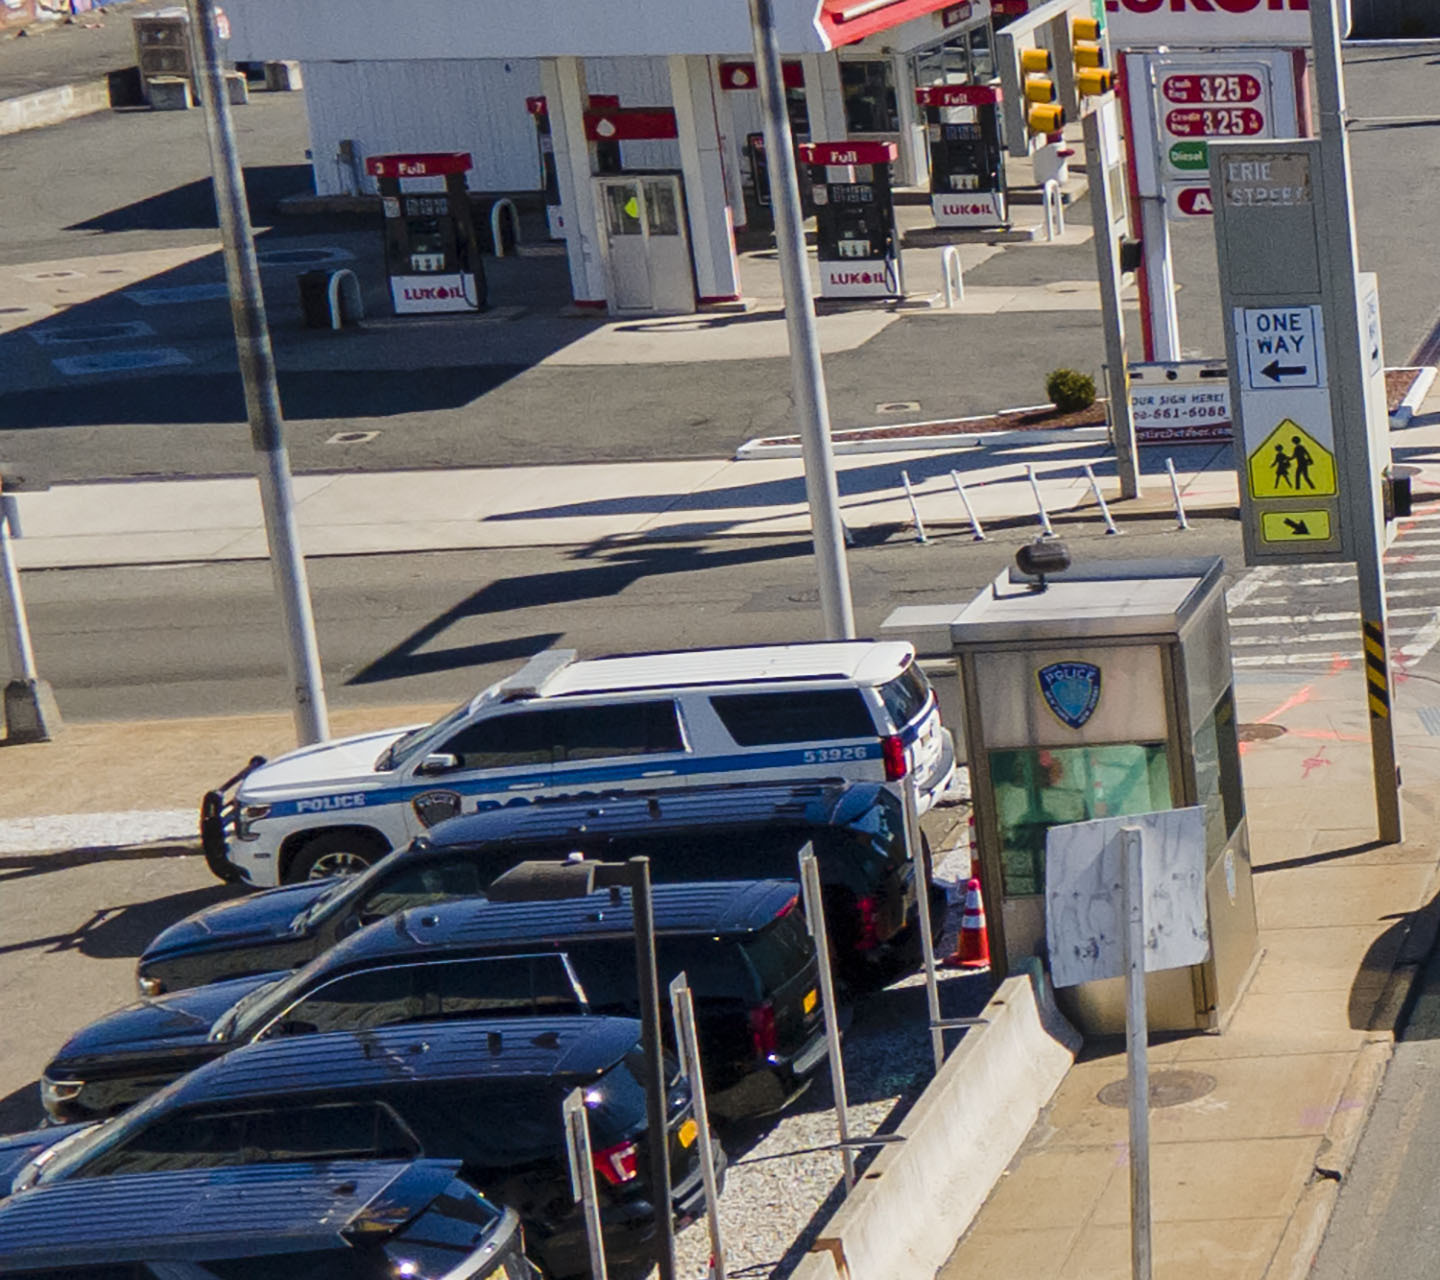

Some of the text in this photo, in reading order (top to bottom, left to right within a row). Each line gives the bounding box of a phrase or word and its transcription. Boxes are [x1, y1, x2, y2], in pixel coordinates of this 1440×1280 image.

[1169, 79, 1191, 89] Cash
[1200, 76, 1241, 102] 3.25
[944, 93, 968, 105] Full
[1202, 110, 1244, 134] 3.25
[830, 151, 857, 163] Full
[1171, 151, 1204, 162] Diesel
[398, 162, 426, 175] Full
[1229, 162, 1272, 182] ERIE
[943, 203, 993, 216] LUKOIL
[830, 271, 886, 286] LUKOIL
[403, 285, 463, 301] LUKOIL
[1257, 313, 1303, 333] ONE
[1257, 334, 1306, 355] WAY
[1160, 395, 1186, 406] SIGN
[1192, 393, 1224, 404] HERE!
[1044, 668, 1096, 684] POLICE
[804, 746, 867, 764] 53926
[297, 793, 366, 813] POLICE
